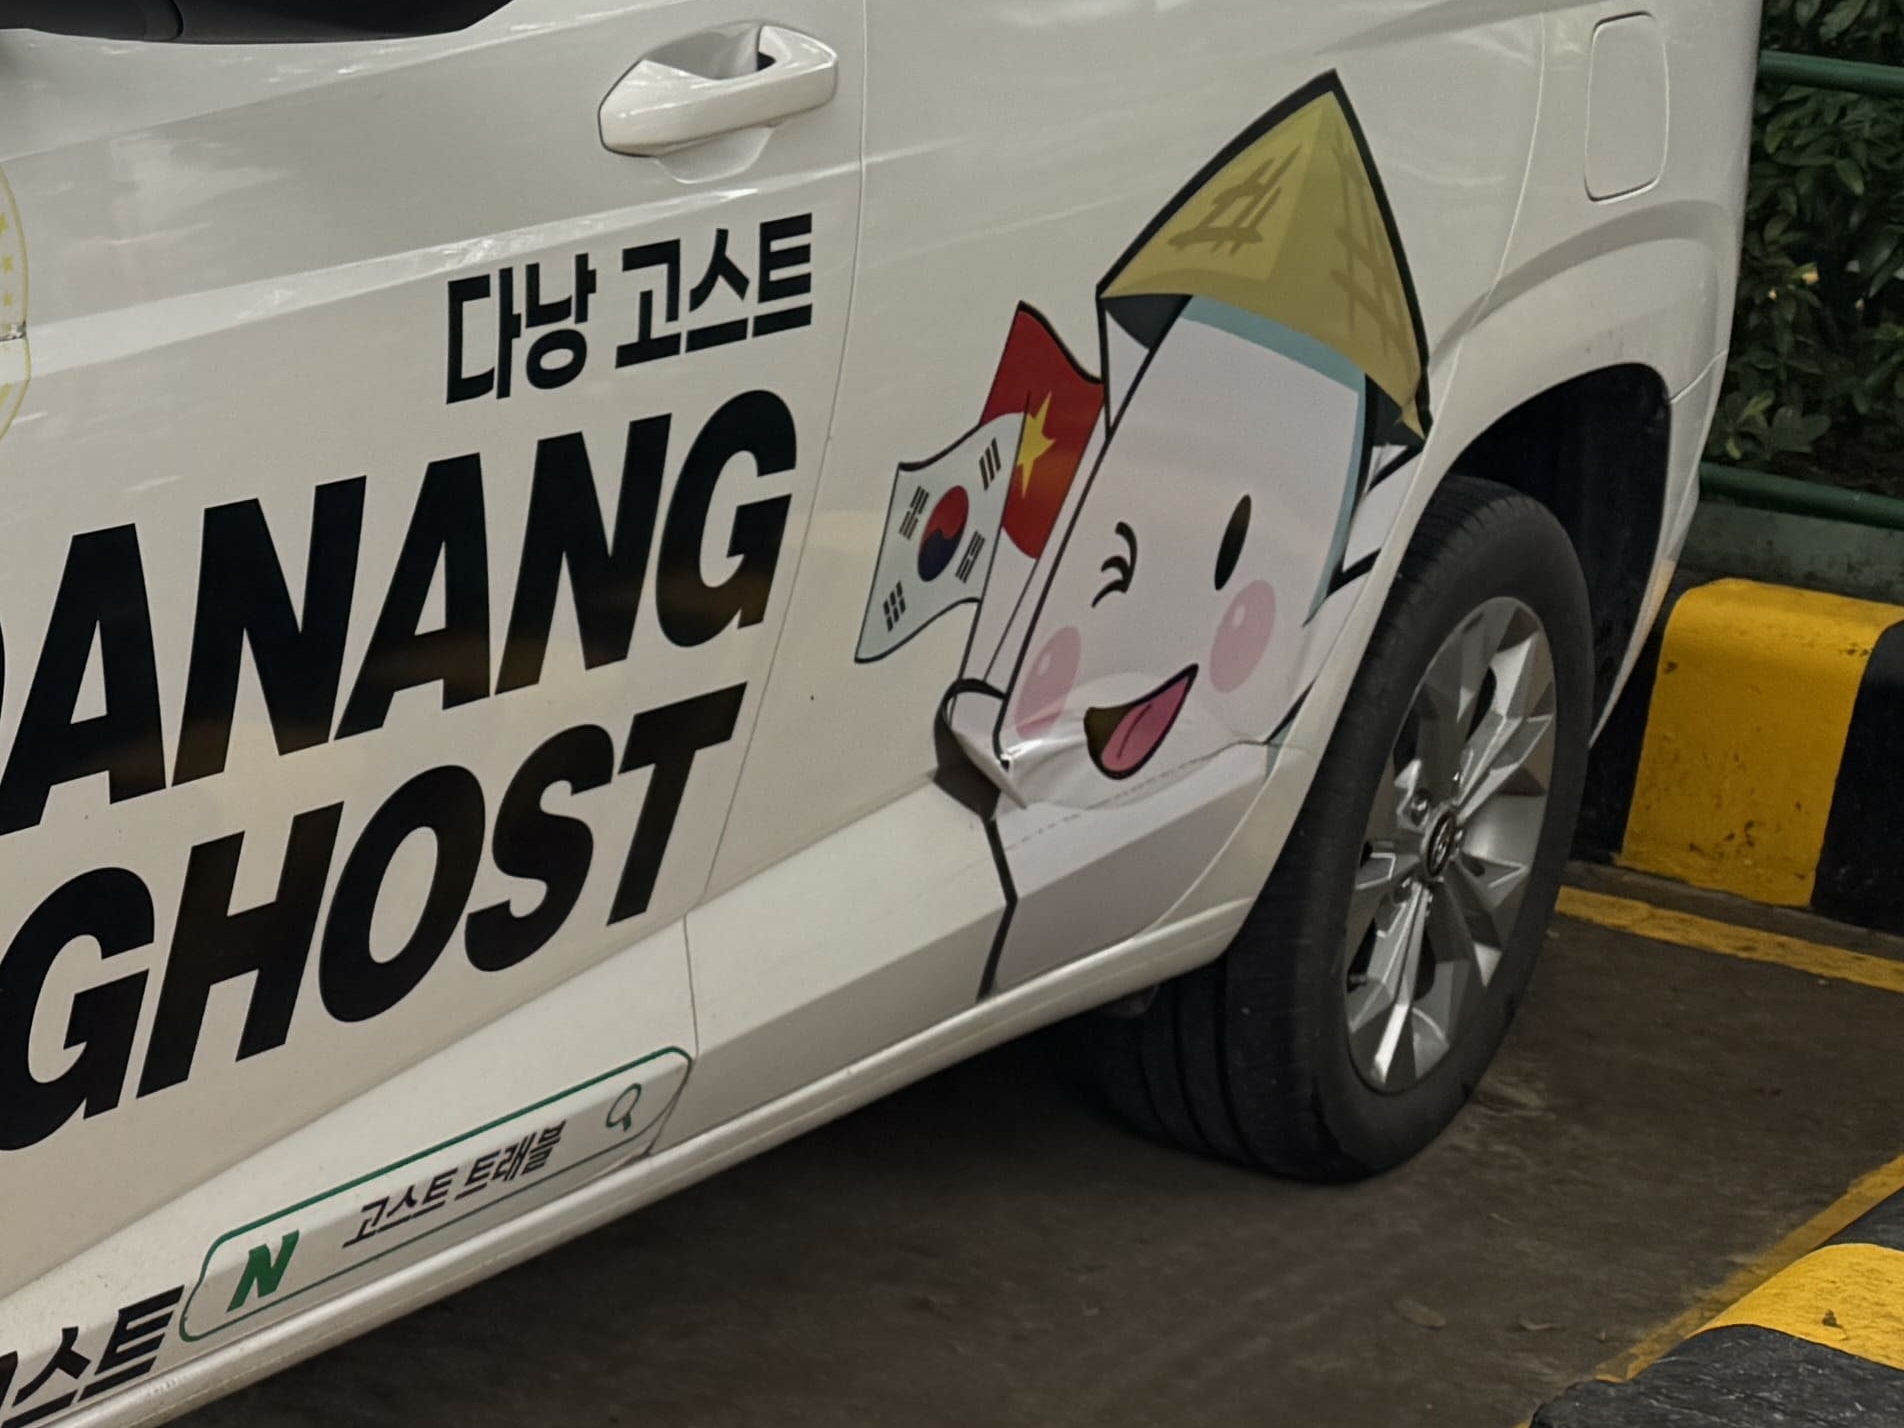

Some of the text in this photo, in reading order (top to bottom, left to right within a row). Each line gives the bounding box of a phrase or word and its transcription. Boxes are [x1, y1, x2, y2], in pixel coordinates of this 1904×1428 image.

[446, 212, 813, 404] 다낭 고스트
[342, 1120, 566, 1248] 고스트 트래블
[227, 1231, 300, 1312] N
